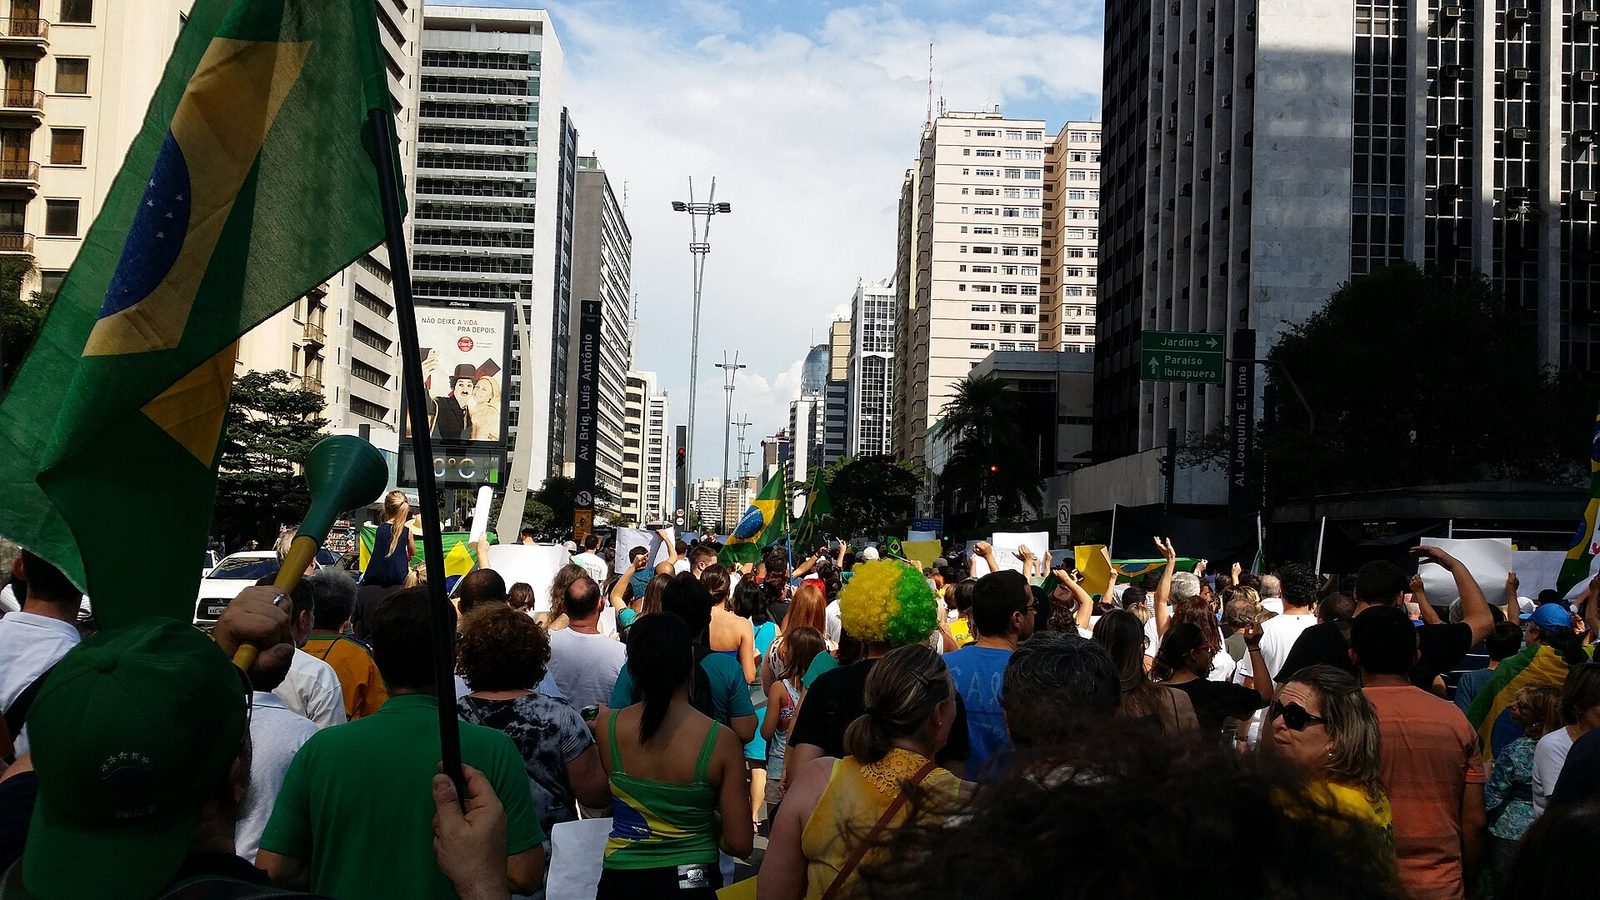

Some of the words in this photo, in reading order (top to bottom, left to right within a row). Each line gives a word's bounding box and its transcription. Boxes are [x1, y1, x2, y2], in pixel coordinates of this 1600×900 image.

[1160, 337, 1200, 347] Jardins
[581, 333, 593, 381] Antônio
[1164, 367, 1216, 379] Ibirapuera
[1236, 366, 1247, 397] Lima
[1236, 400, 1247, 410] E.
[579, 413, 592, 440] Brig.
[1236, 414, 1248, 467] Joaquim
[578, 444, 589, 461] Av.
[1235, 471, 1245, 487] Al.
